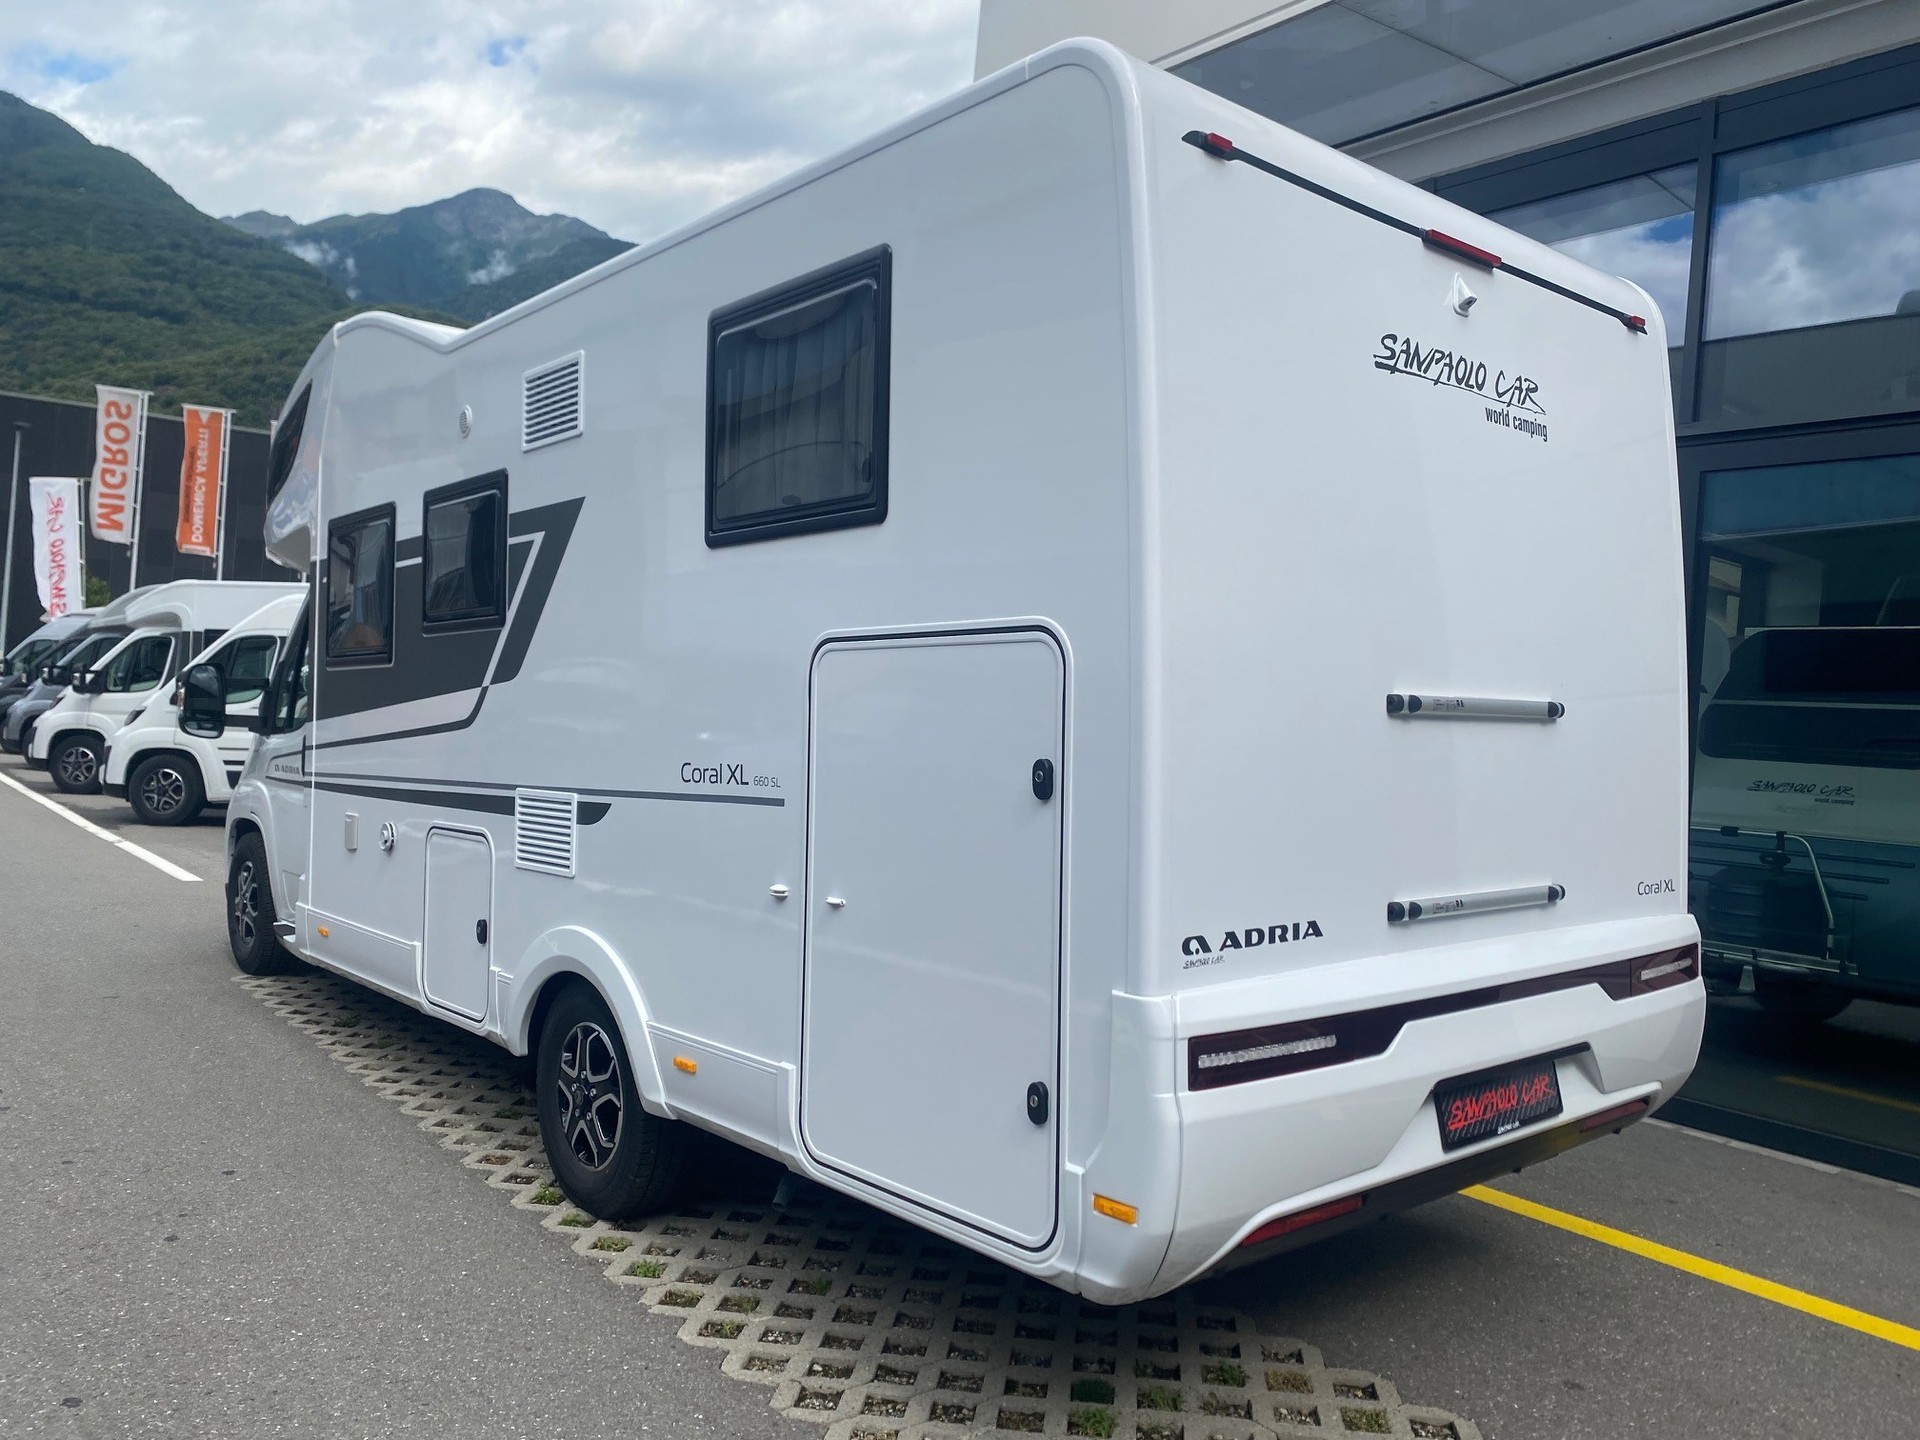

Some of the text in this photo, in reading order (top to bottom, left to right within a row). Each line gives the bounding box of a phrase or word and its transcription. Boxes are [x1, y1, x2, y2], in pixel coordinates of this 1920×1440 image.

[1373, 333, 1546, 415] SANPAOLO CAR
[1485, 407, 1548, 442] world camping
[681, 762, 781, 788] Coral XL 660 SL
[1637, 879, 1675, 895] Coral XL
[1219, 920, 1324, 951] ADRIA
[1448, 1075, 1556, 1130] SANPAOLO CAR
